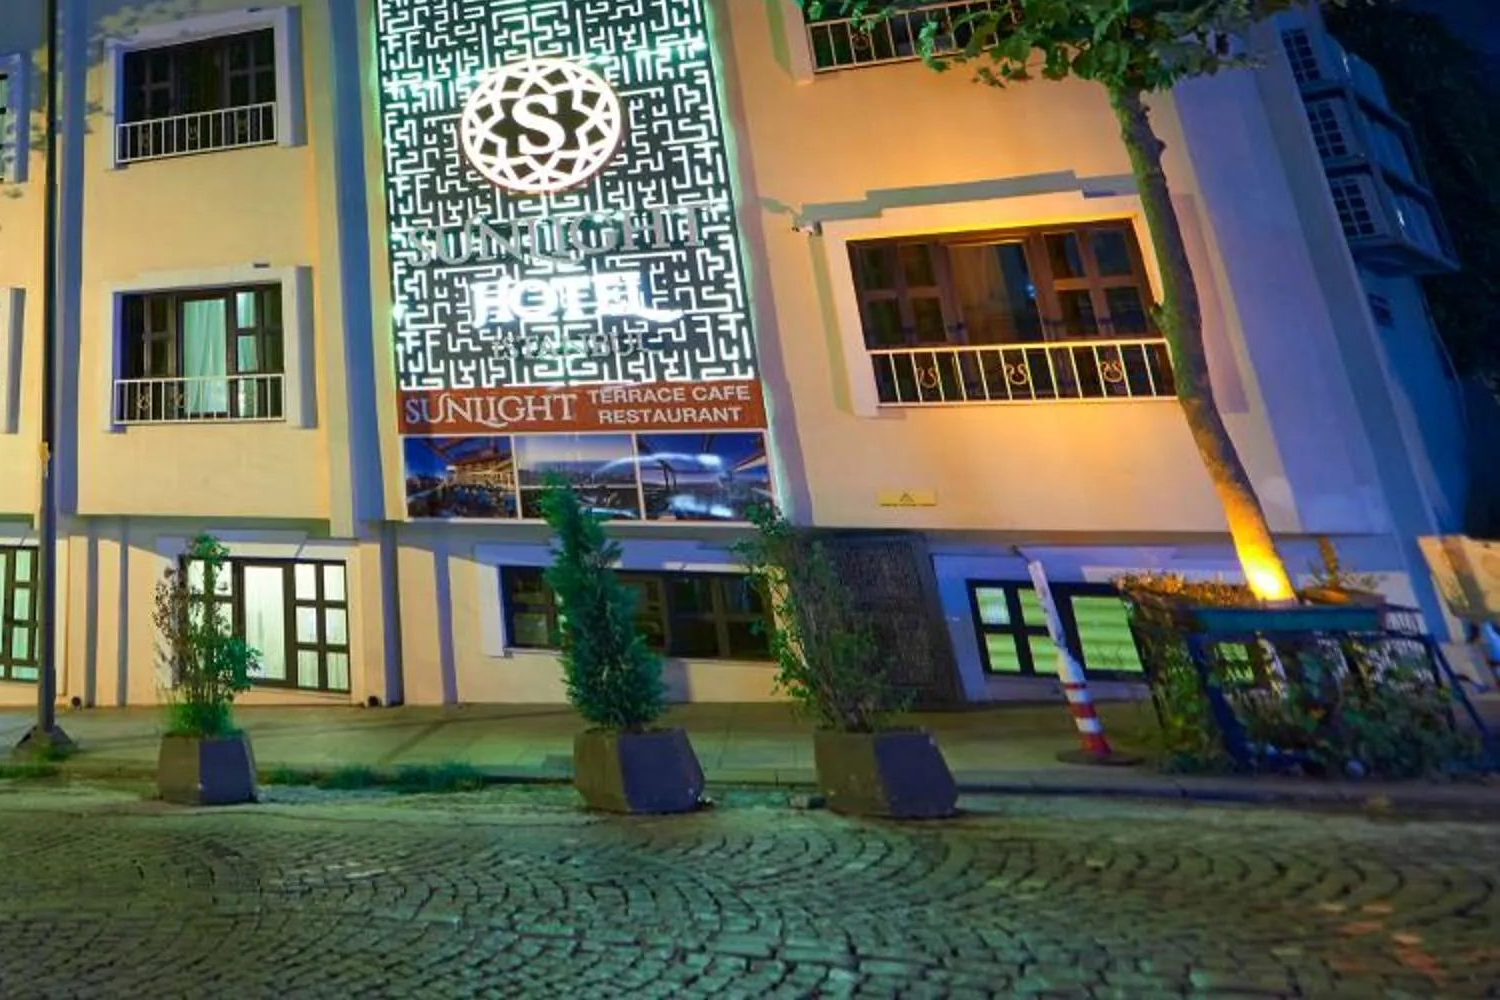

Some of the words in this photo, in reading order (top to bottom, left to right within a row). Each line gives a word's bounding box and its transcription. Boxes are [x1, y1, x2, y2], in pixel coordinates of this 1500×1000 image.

[511, 94, 566, 155] S
[407, 203, 712, 267] SUNLIGHT
[470, 271, 684, 328] HOTEL
[405, 391, 578, 427] SUNLIGHT
[588, 386, 686, 404] TERRACE
[692, 385, 751, 401] CAFE
[599, 407, 742, 424] RESTAURANT
